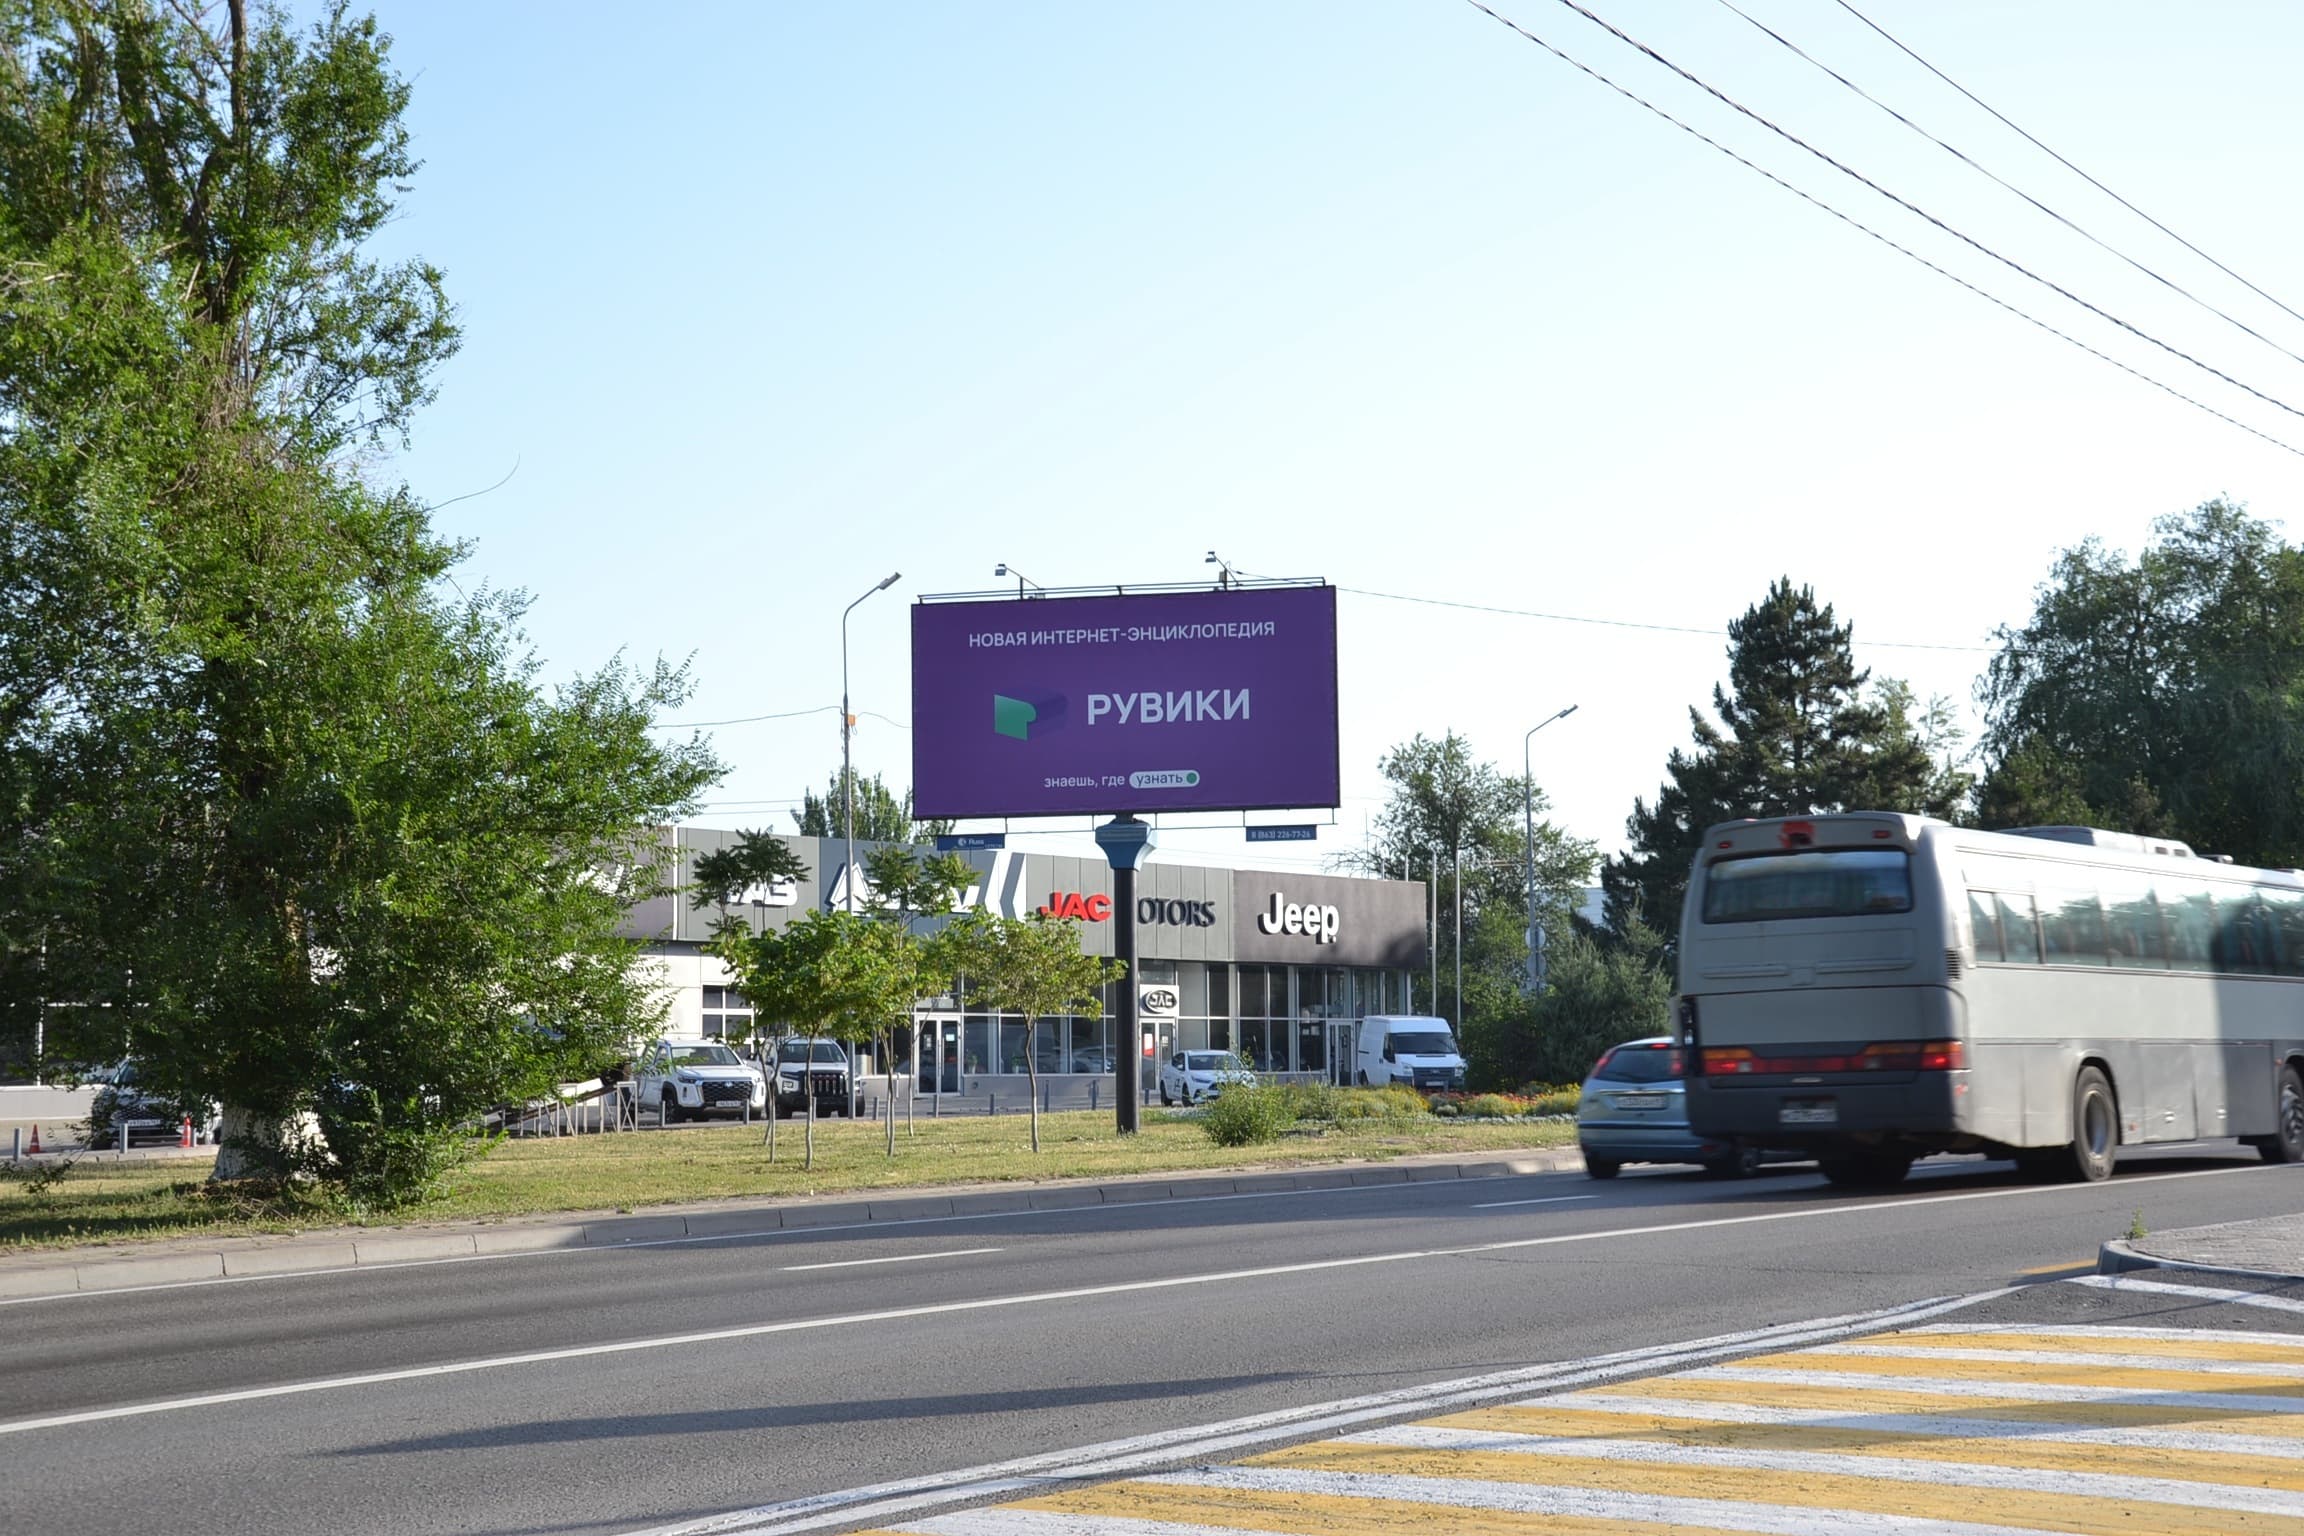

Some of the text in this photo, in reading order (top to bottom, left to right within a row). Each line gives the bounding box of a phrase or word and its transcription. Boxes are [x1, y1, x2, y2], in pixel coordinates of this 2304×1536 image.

[969, 621, 1275, 649] НОВАЯ ИНТЕРНЕТ-ЭНЦИКЛОПЕДИЯ
[1087, 688, 1250, 725] РУВИКИ
[1044, 772, 1183, 788] знаешь, где узнать
[1037, 891, 1216, 927] JAC OTORS
[1258, 892, 1340, 944] Jeep
